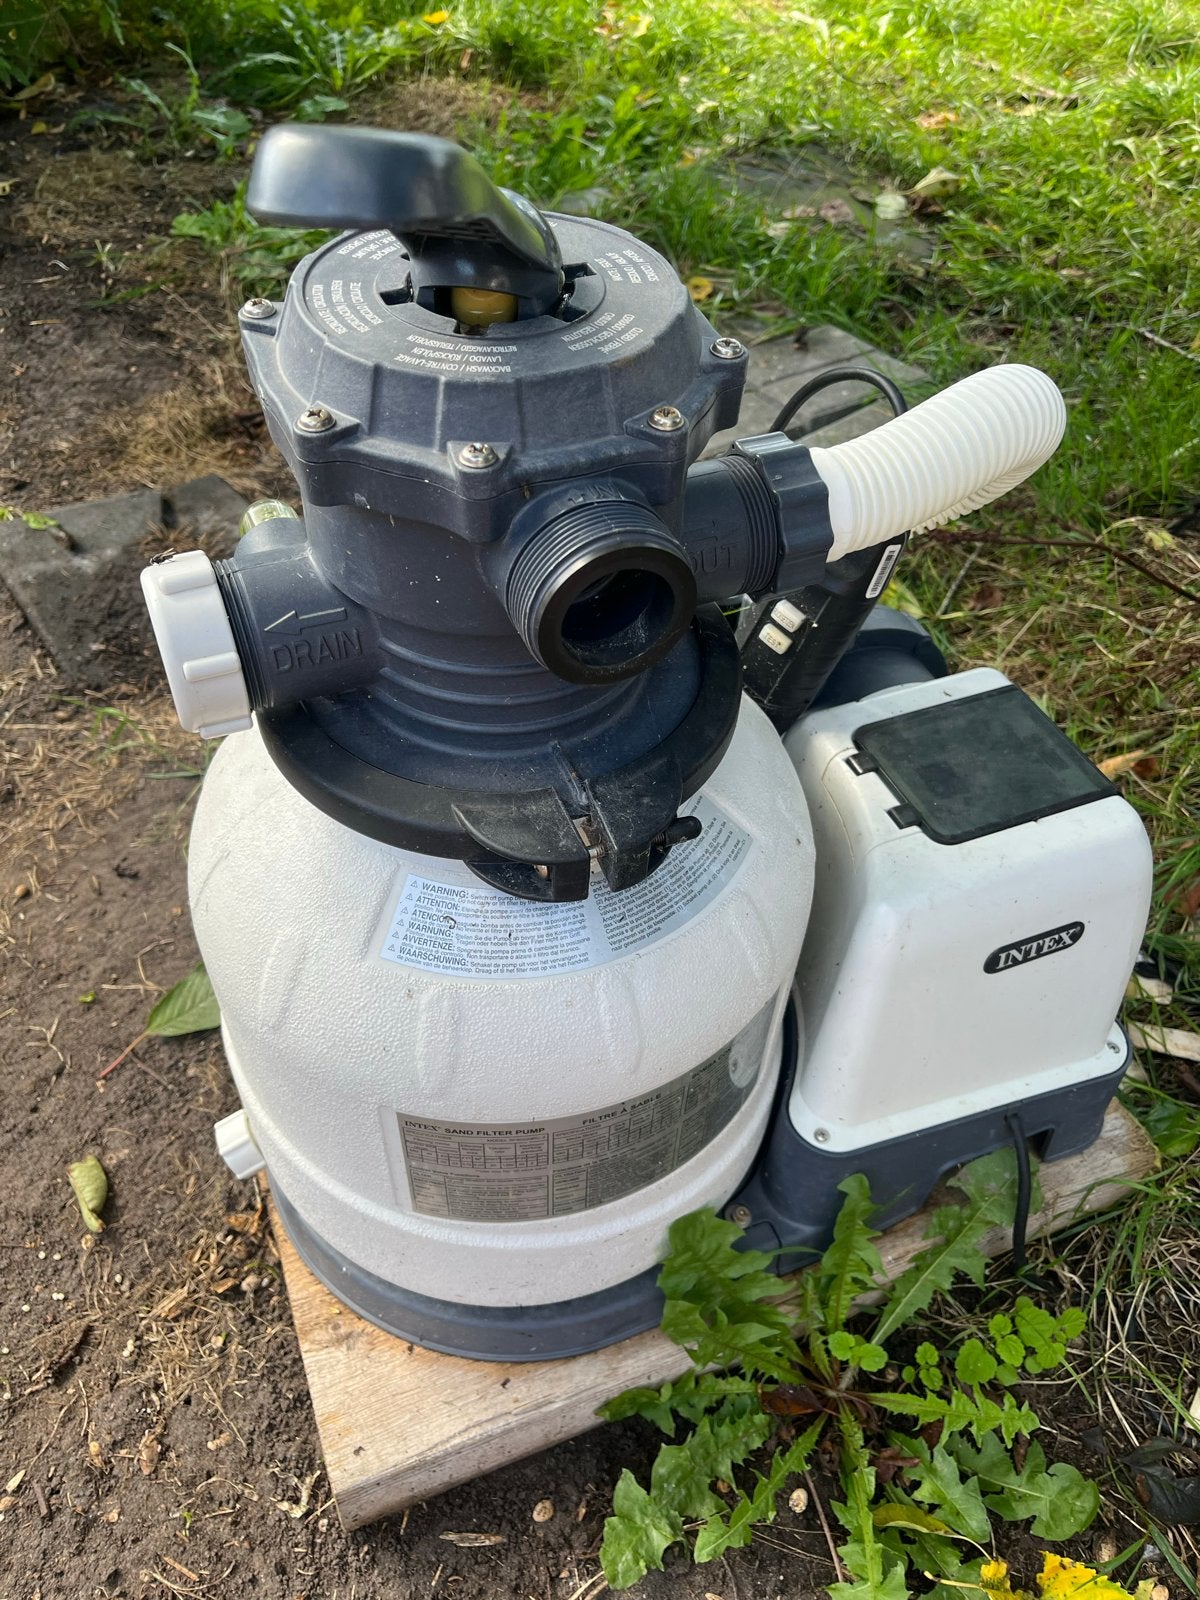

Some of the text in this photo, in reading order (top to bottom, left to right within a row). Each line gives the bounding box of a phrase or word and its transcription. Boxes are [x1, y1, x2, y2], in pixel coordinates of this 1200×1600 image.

[406, 335, 454, 349] TERUGSPOELEN
[621, 328, 643, 341] CLOSED
[394, 353, 458, 370] CONTRE-LAVAGE
[411, 347, 462, 362] RÜCKSPÜLEN
[270, 628, 363, 673] DRAIN
[422, 882, 469, 898] WARNING:
[415, 895, 460, 911] ATTENTION:
[408, 920, 454, 938] WARNUNG:
[402, 933, 455, 951] AVVERTENZE:
[995, 927, 1078, 970] INTEX
[399, 945, 469, 966] WAARSCHUWING:
[582, 1110, 618, 1125] FILTRE
[630, 1093, 662, 1110] SABLE
[404, 1120, 438, 1131] INTEX
[444, 1128, 474, 1136] SAND
[515, 1127, 546, 1135] PUMP
